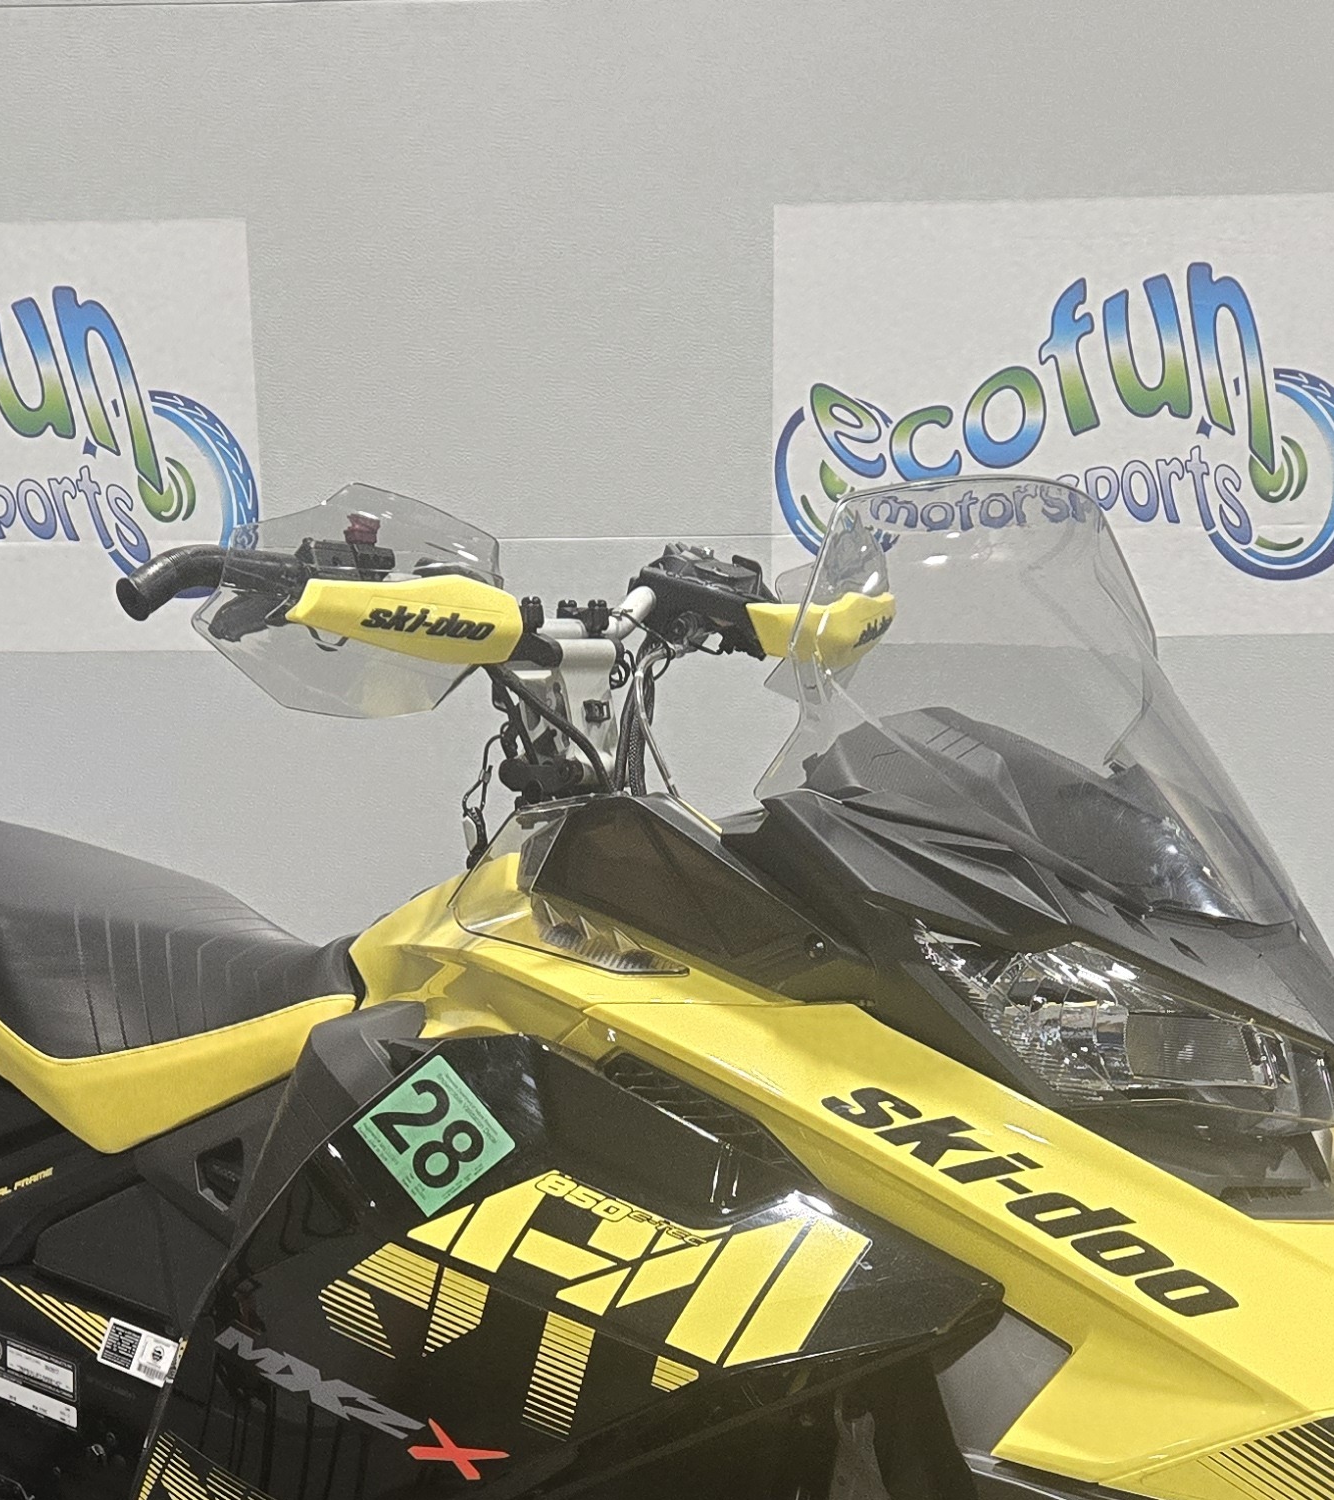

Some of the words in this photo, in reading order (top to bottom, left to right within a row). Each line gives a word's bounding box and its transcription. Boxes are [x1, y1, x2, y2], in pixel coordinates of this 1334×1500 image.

[869, 444, 1253, 545] motorsports
[360, 605, 495, 641] ski-doo
[369, 1079, 484, 1189] 28
[13, 1167, 54, 1191] FRAME
[535, 1174, 633, 1222] 850
[821, 1087, 1239, 1317] ski-doo
